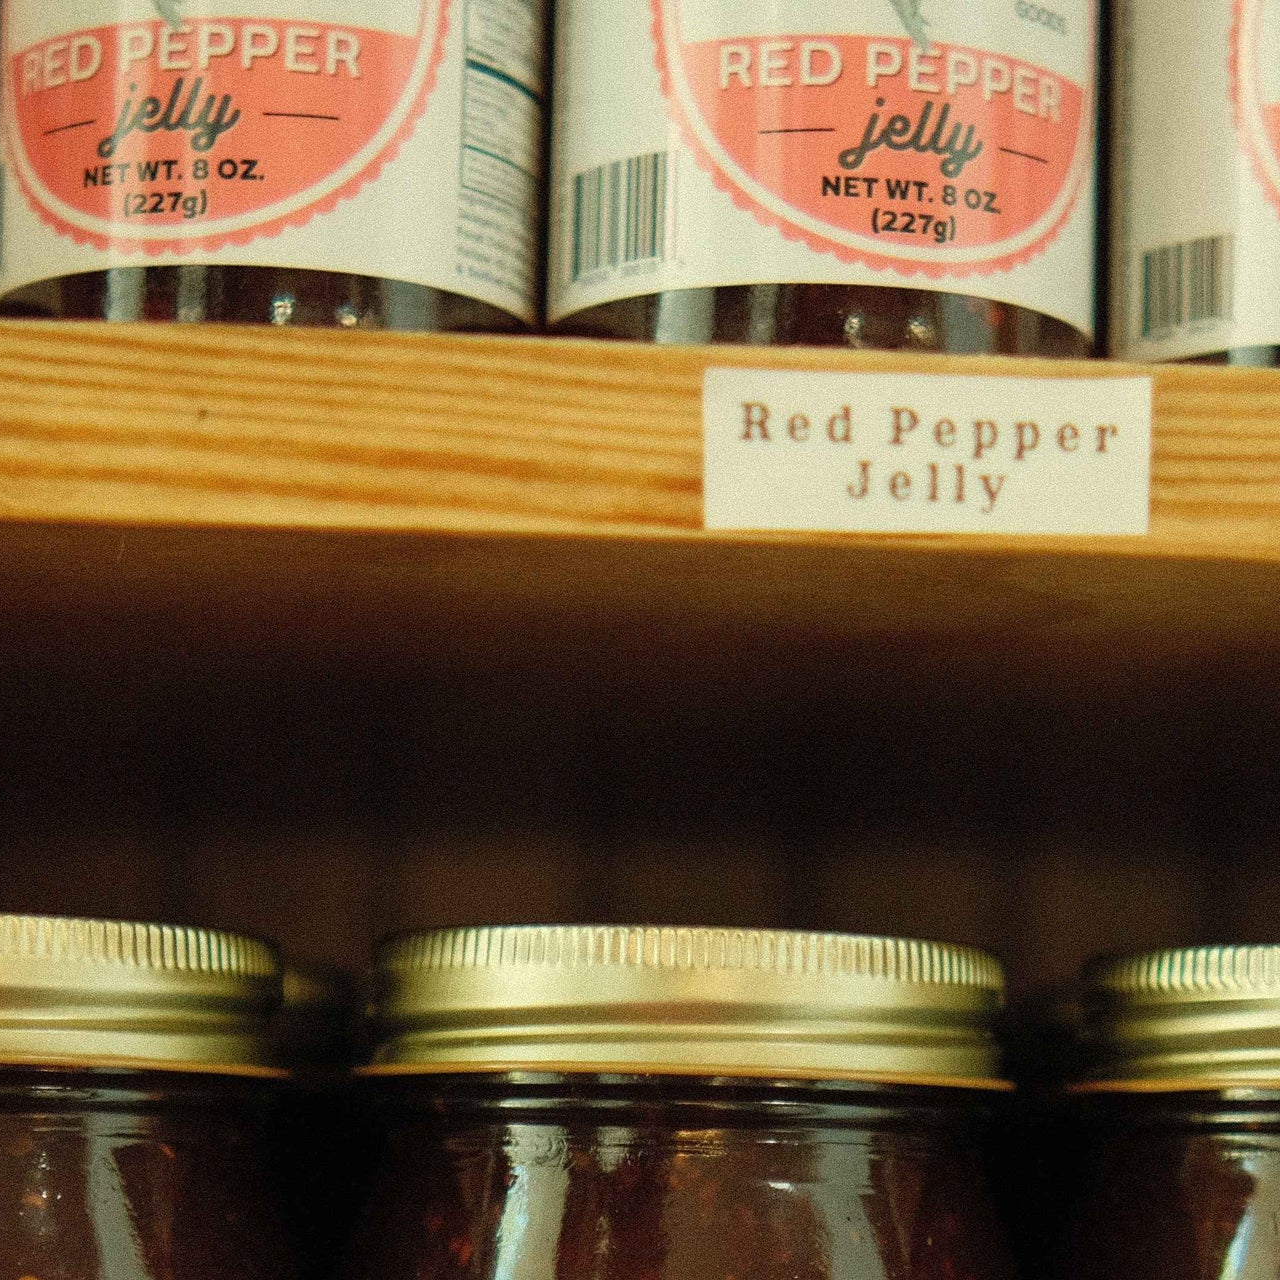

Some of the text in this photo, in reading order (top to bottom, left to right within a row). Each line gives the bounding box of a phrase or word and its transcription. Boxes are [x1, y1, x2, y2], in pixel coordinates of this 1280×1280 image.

[23, 26, 362, 93] RED PEPPER
[720, 41, 1061, 123] RED PEPPER
[97, 77, 241, 157] jelly
[839, 97, 982, 178] jelly
[84, 158, 265, 188] NET WT. 8 OZ.
[821, 176, 876, 199] NET
[885, 178, 933, 203] WT.
[942, 182, 957, 205] 8
[124, 192, 208, 219] (227g)
[872, 209, 956, 244] (227g)
[741, 401, 1119, 460] Red Pepper
[847, 459, 1007, 514] Jelly
